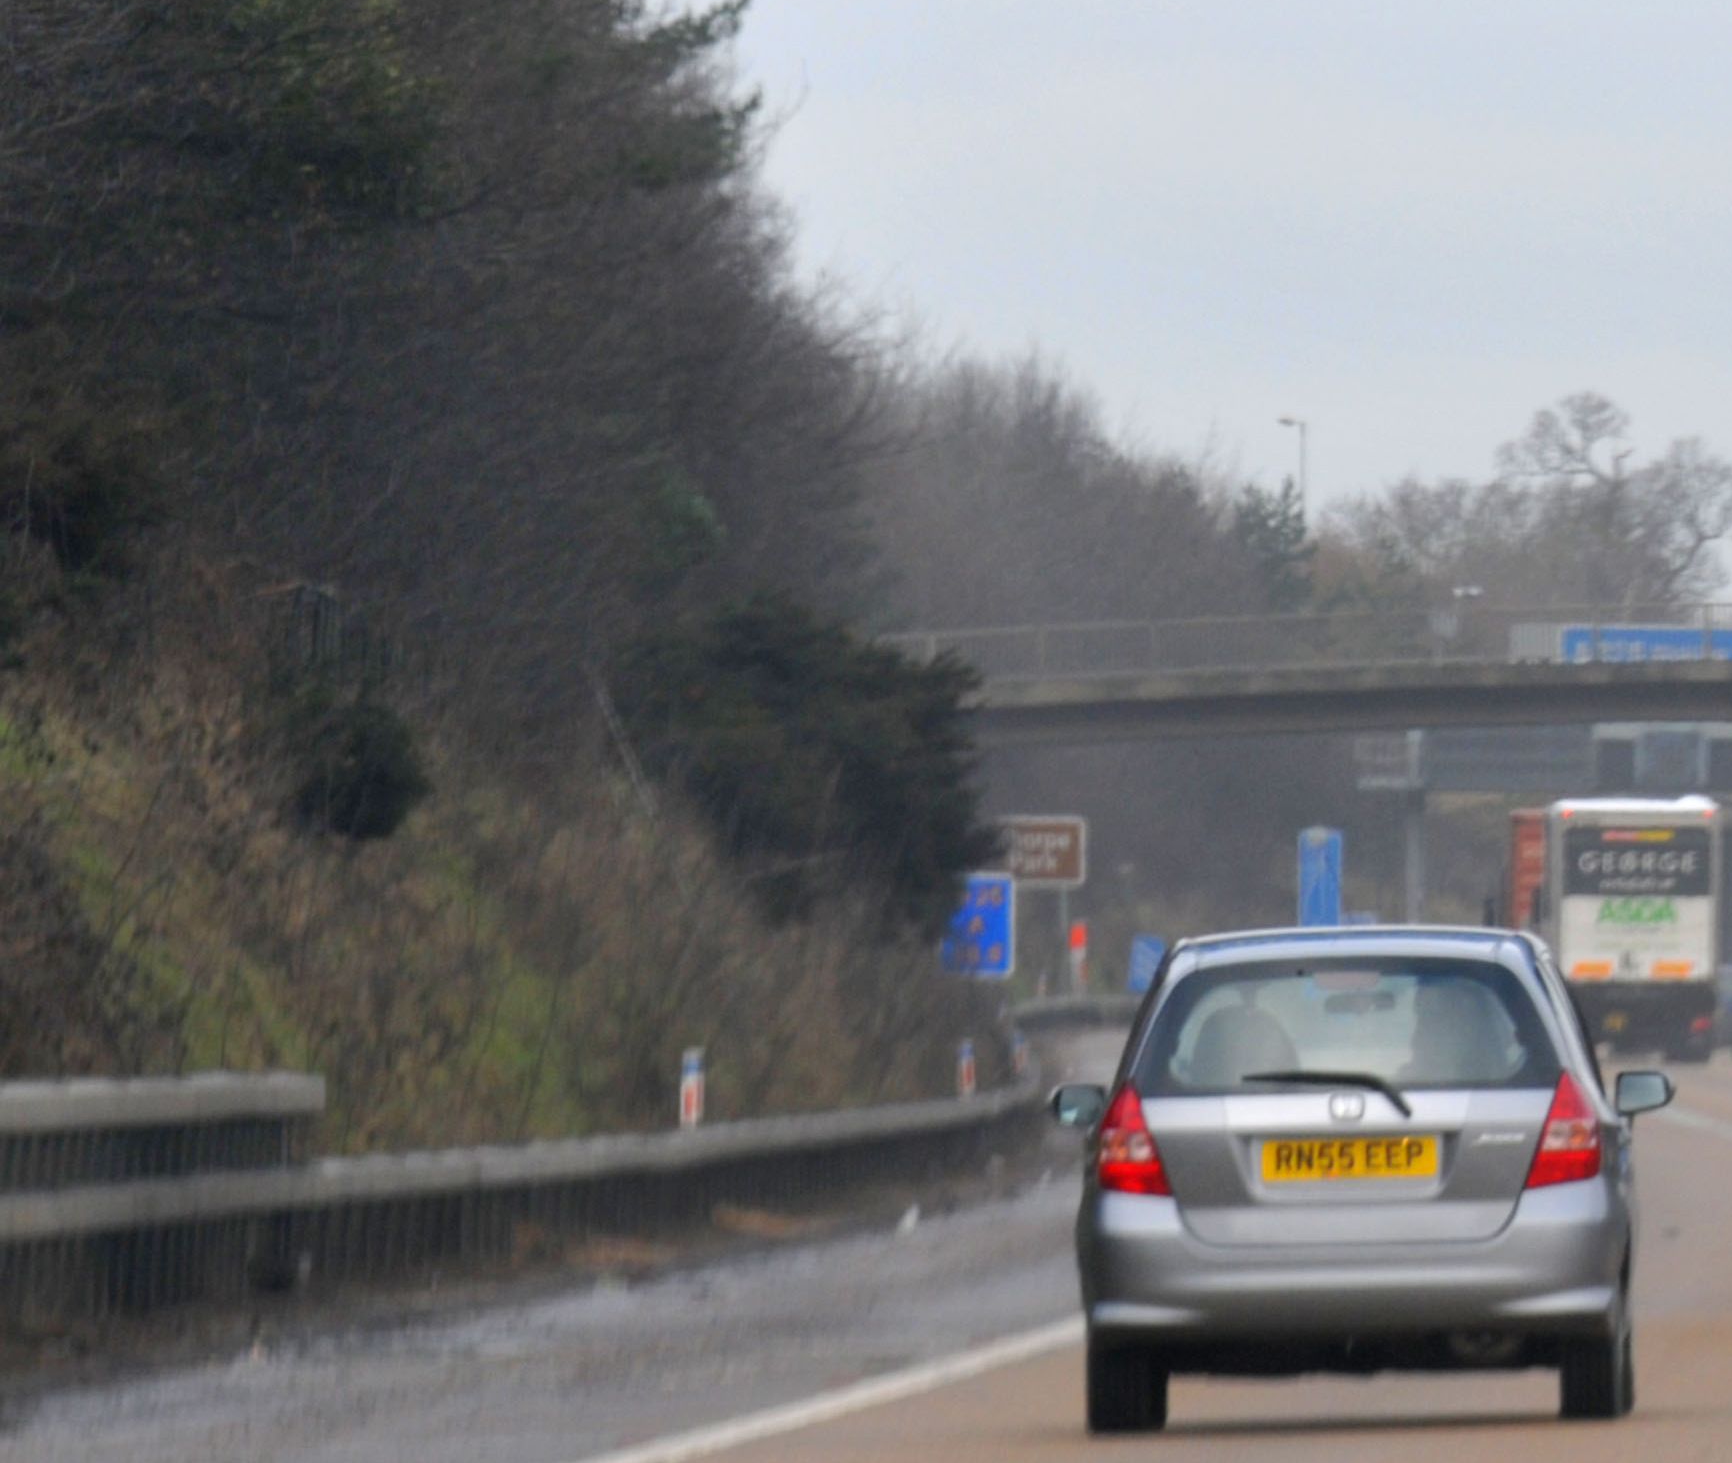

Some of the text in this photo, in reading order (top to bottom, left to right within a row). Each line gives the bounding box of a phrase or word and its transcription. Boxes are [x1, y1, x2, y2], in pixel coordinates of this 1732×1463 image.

[1599, 897, 1677, 924] ASDA
[1275, 1139, 1424, 1172] RN55 EEP
